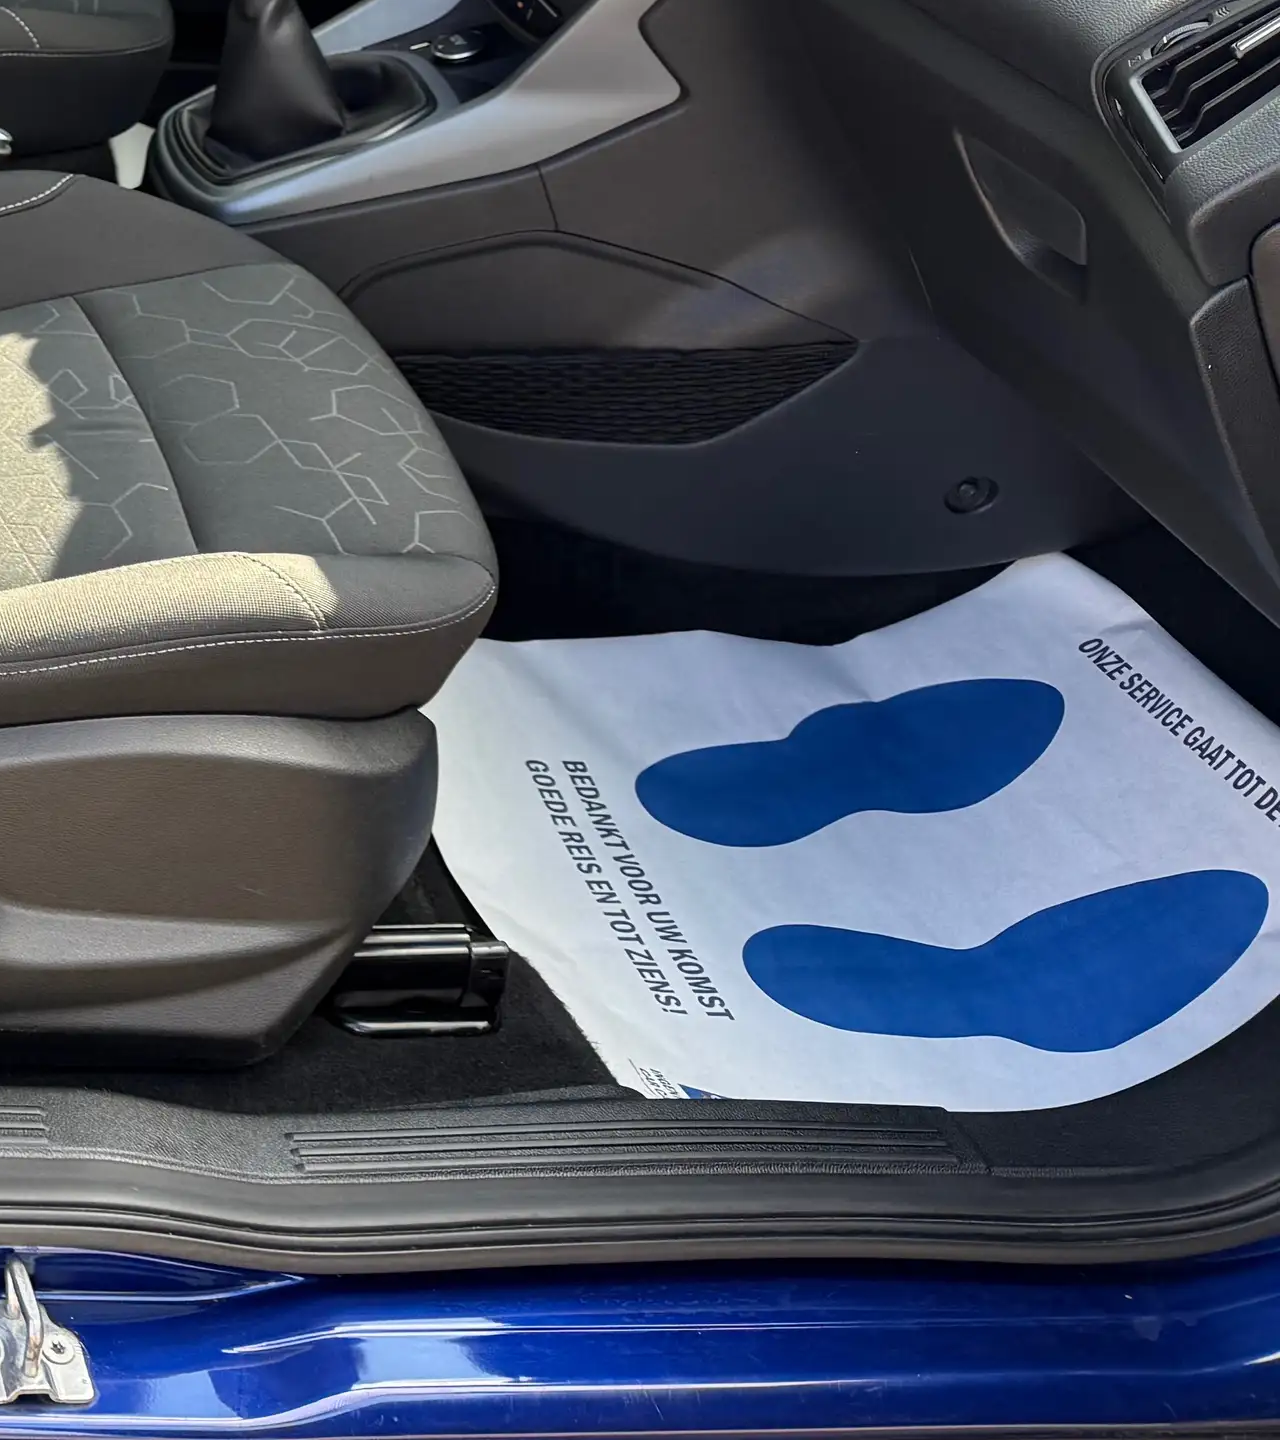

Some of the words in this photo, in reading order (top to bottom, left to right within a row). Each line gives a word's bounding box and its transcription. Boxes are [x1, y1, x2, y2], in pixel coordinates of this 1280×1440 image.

[1078, 638, 1133, 681] ONZE
[1119, 672, 1194, 737] SERVICE
[1183, 726, 1235, 772] GAAT
[1224, 759, 1267, 798] TOT
[525, 760, 578, 827] GOEDE
[557, 830, 602, 874] REIS
[561, 760, 631, 850] BEDANKT
[612, 853, 662, 905] VOOR
[646, 911, 688, 943] UW
[667, 948, 735, 1020] KOMST
[585, 879, 622, 904] EN
[603, 908, 645, 945] TOT
[624, 947, 688, 1015] ZIENS!
